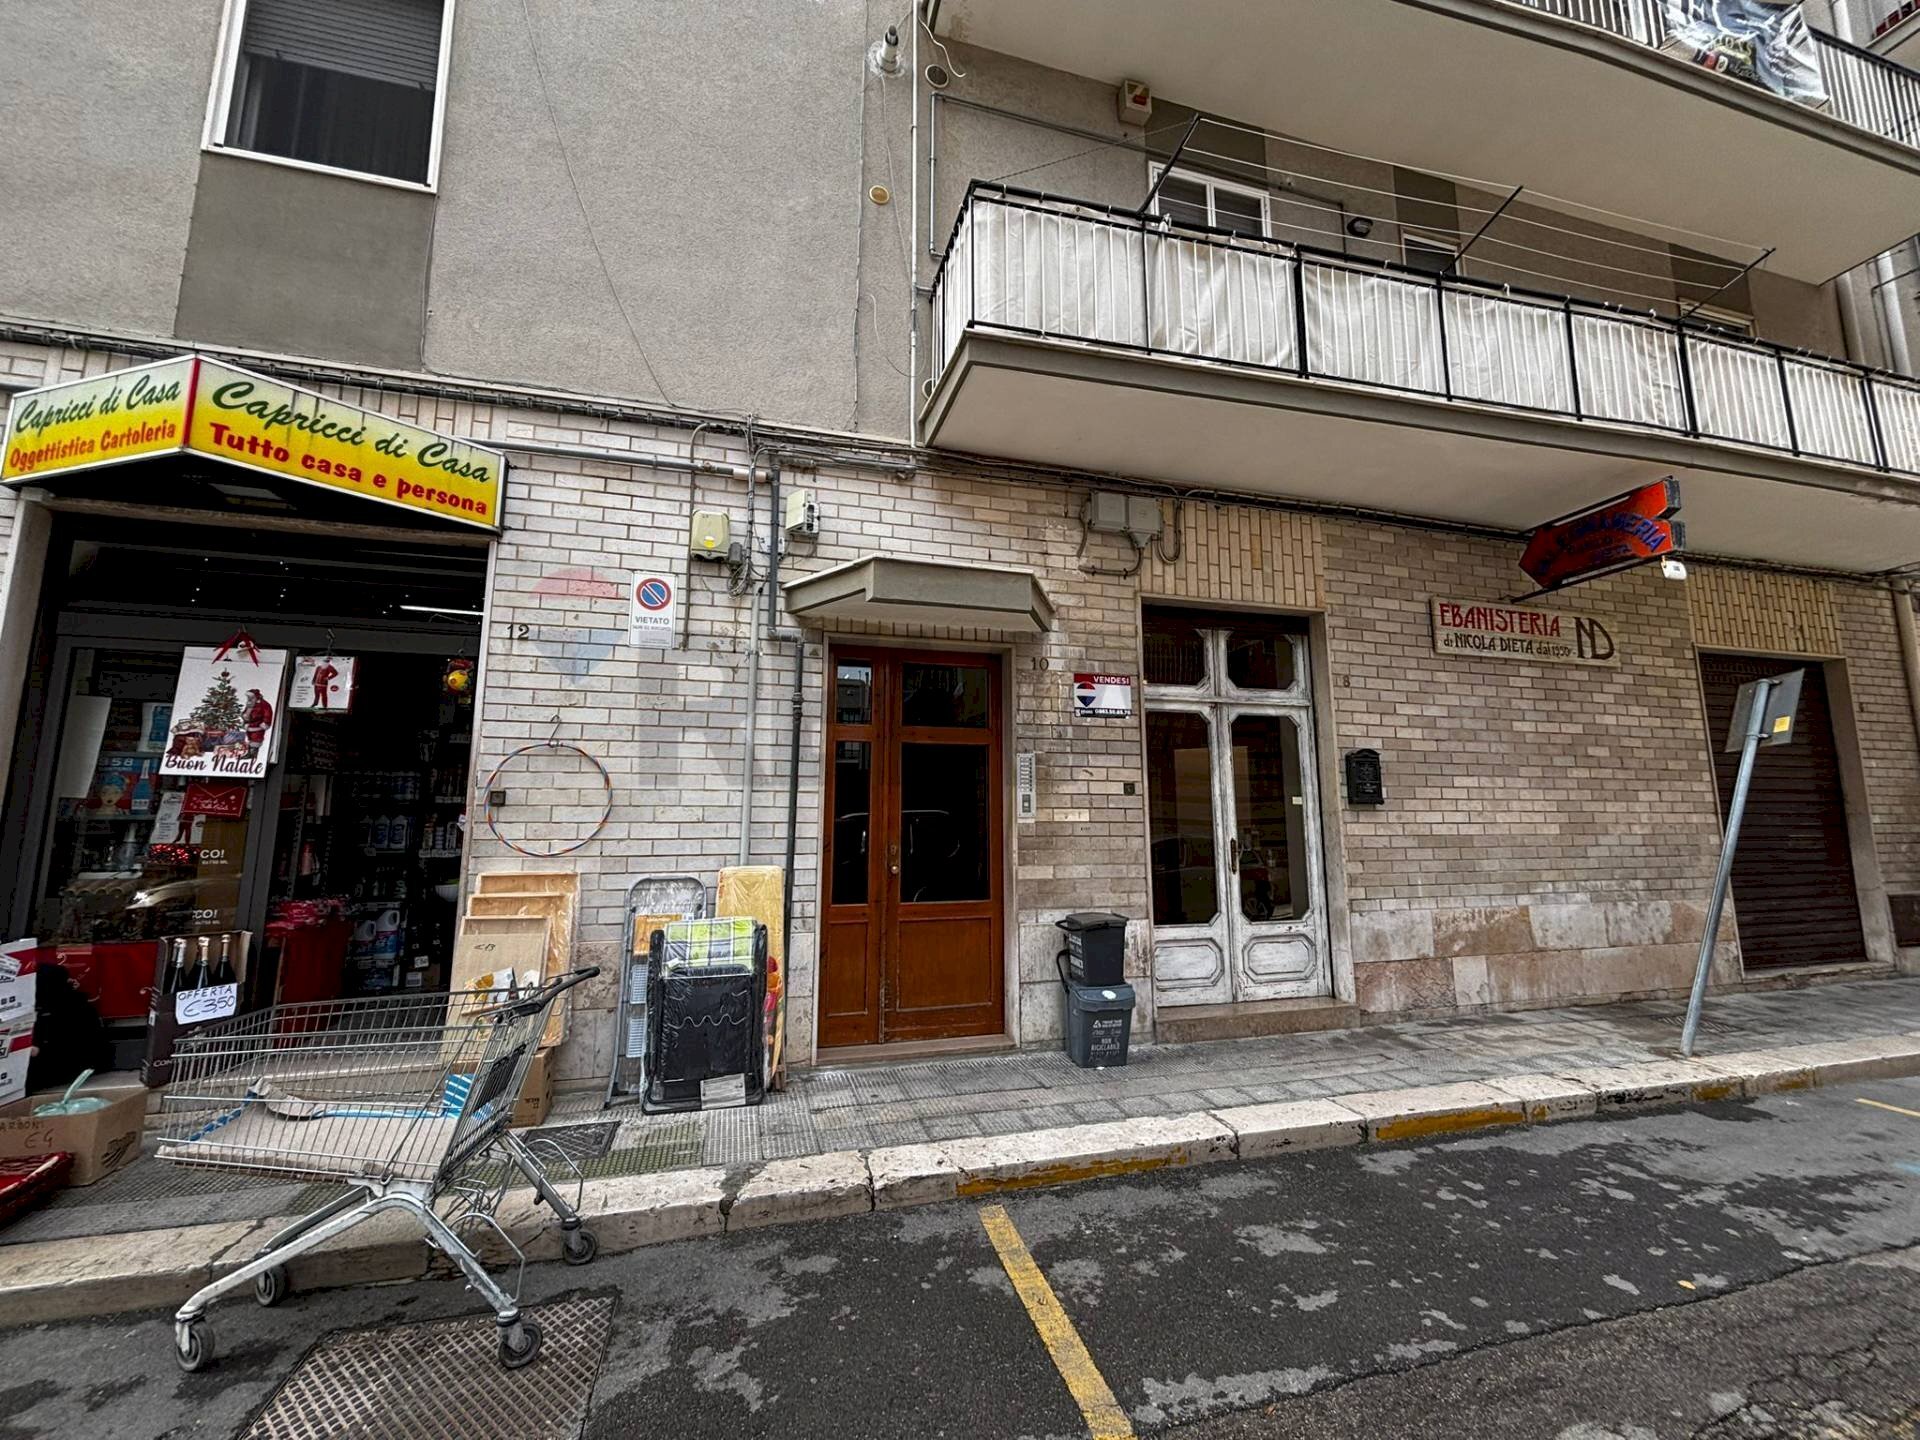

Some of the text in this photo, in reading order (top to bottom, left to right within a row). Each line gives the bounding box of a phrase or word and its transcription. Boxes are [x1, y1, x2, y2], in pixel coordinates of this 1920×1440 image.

[16, 375, 181, 437] Capricci di Casa
[212, 381, 490, 483] Capricci di Casa
[10, 420, 176, 472] Oggettistica Cartoleria
[209, 422, 488, 515] Tutto casa e persona
[635, 616, 670, 625] VIETATO
[1439, 603, 1561, 637] EBANISTERIA
[507, 624, 530, 640] 12
[1443, 634, 1453, 648] di
[1454, 633, 1496, 651] NICOLA
[1500, 637, 1534, 654] DIETA
[1031, 657, 1049, 671] 10
[1093, 676, 1129, 685] VENDESI
[165, 752, 263, 775] Buon Natale
[178, 985, 232, 1000] OFFERTA
